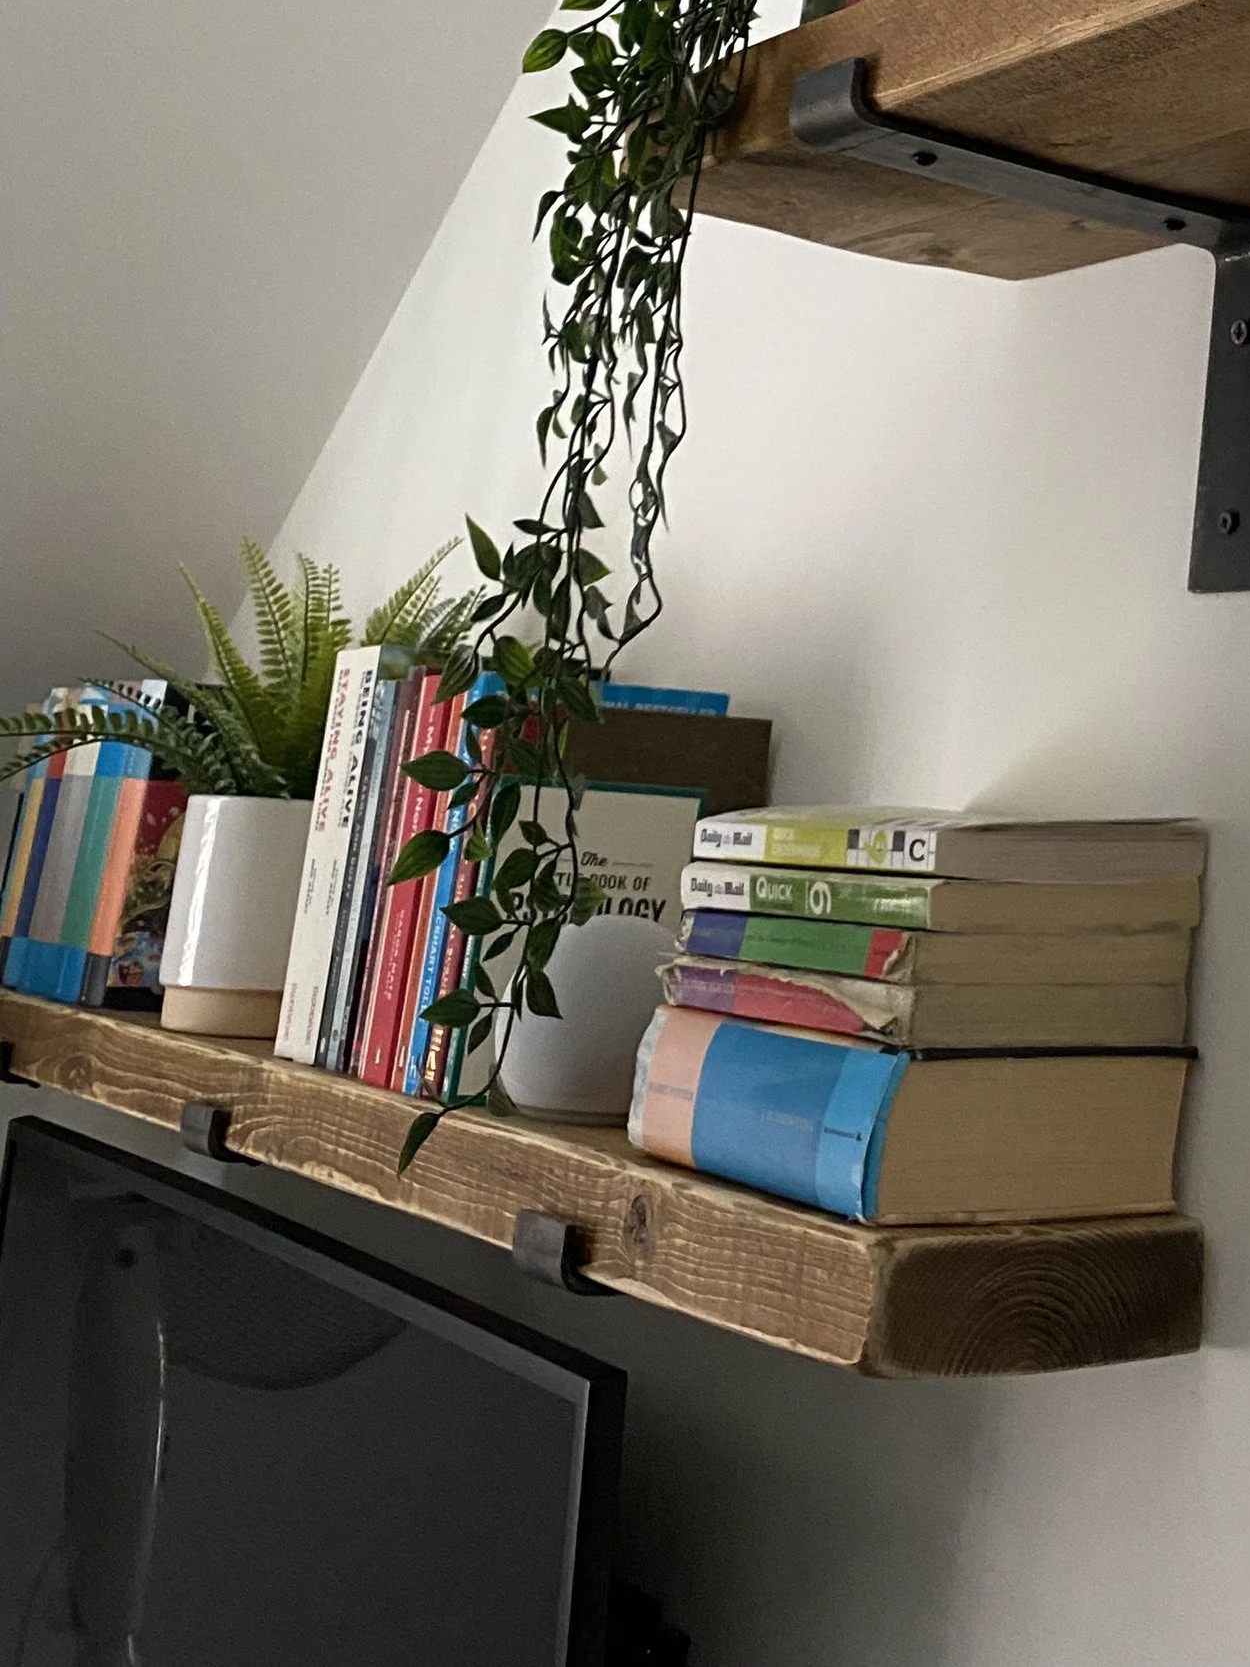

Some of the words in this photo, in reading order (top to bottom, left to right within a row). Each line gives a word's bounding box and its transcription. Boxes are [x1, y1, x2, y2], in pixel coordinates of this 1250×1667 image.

[330, 668, 351, 761] STAYING
[355, 669, 373, 745] BEING
[319, 768, 334, 832] ALIVE
[341, 753, 359, 828] ALIVE
[580, 851, 608, 867] The
[700, 828, 722, 848] Daily
[733, 831, 753, 847] Mail
[908, 838, 927, 862] C
[632, 876, 652, 892] OF
[691, 877, 713, 897] Daily
[724, 880, 746, 897] Mail
[428, 915, 441, 975] CKHART
